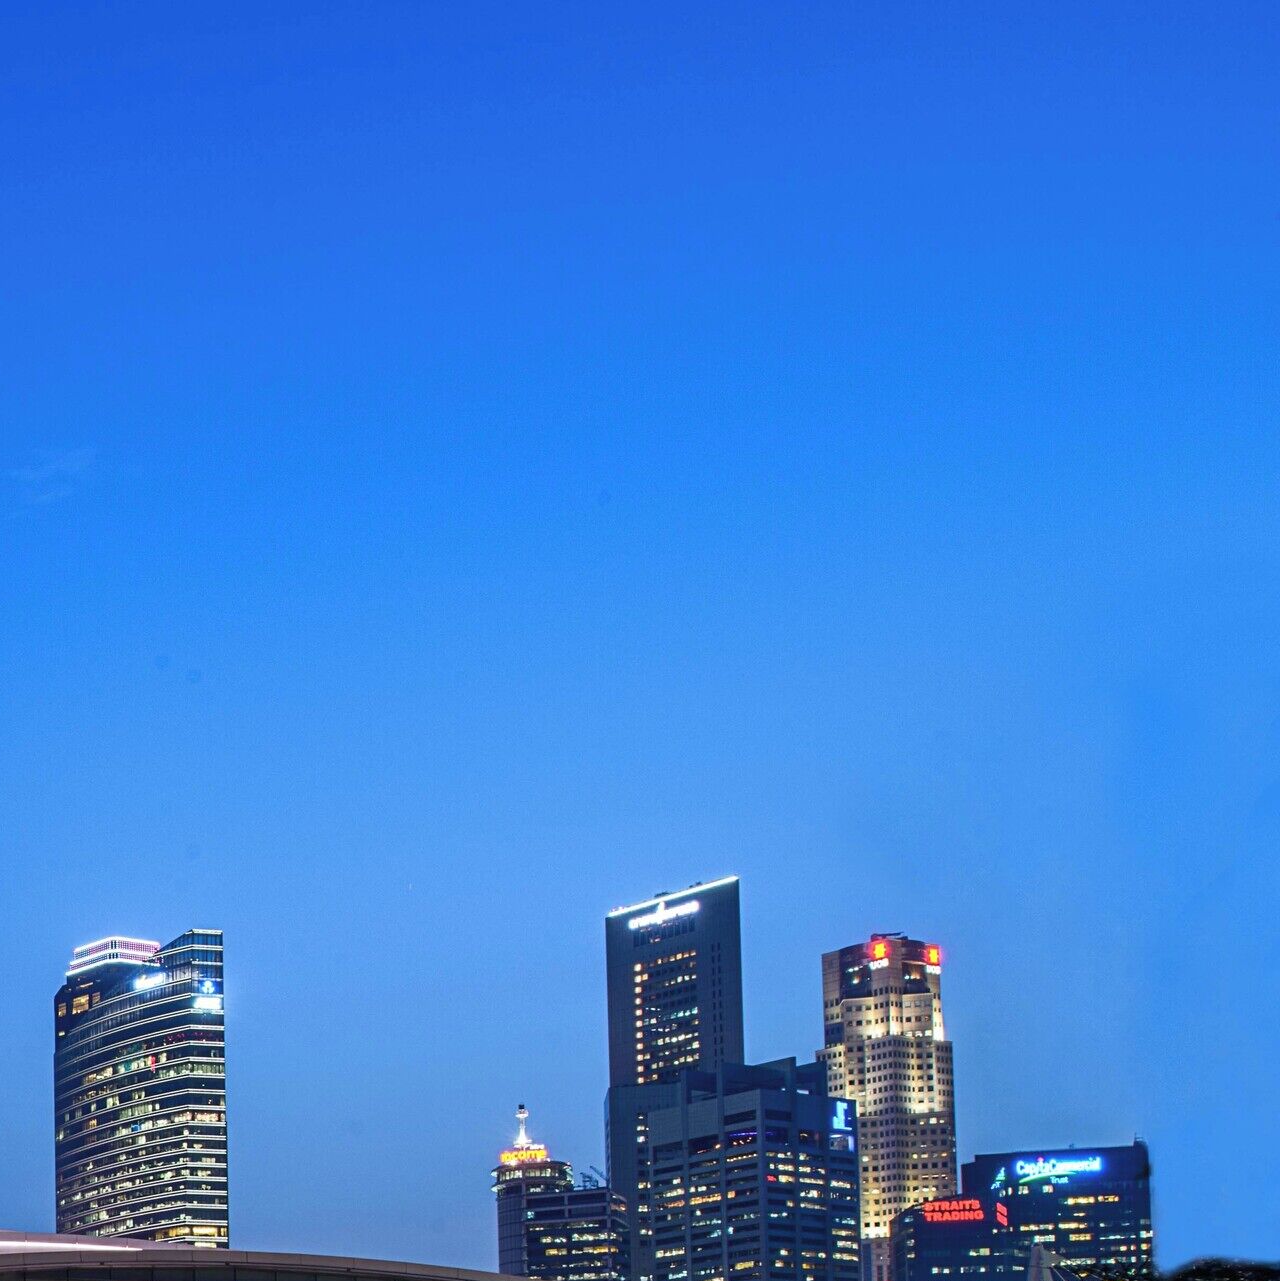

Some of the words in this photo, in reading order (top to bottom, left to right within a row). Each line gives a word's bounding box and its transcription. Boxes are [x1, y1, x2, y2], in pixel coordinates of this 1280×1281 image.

[1049, 1176, 1069, 1184] Trust
[924, 1200, 980, 1212] STRAITS
[925, 1210, 985, 1222] TRADING
